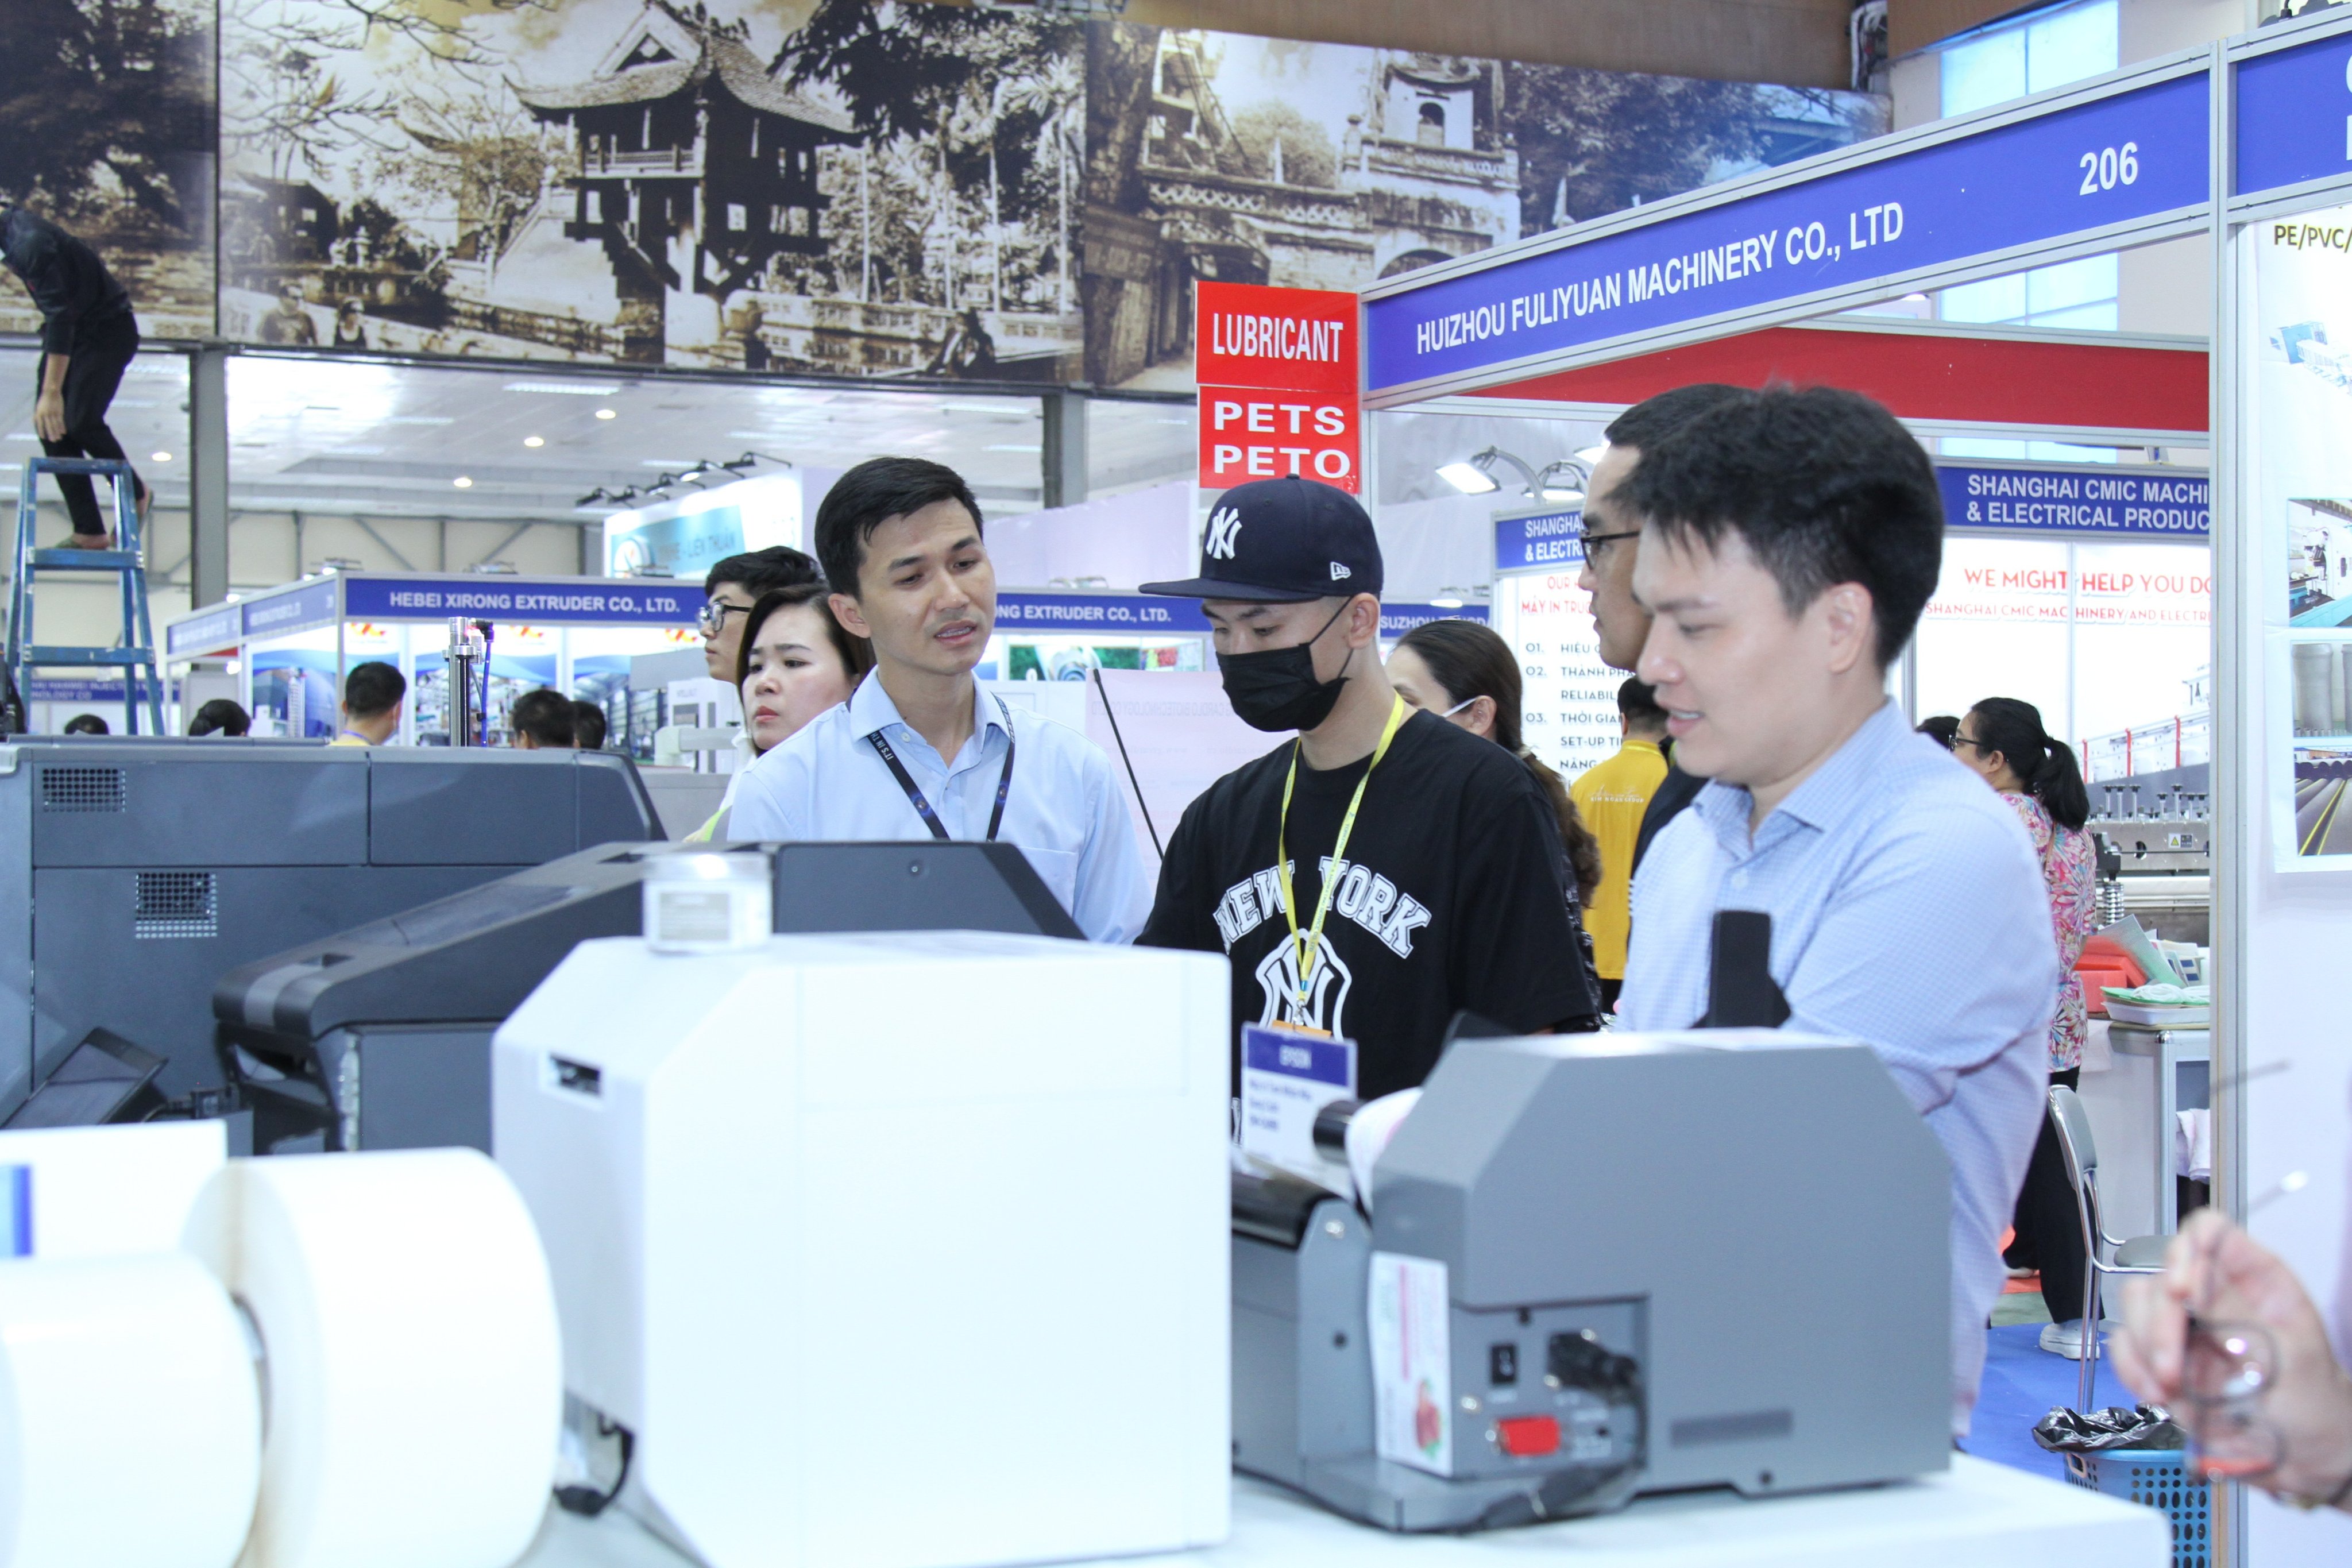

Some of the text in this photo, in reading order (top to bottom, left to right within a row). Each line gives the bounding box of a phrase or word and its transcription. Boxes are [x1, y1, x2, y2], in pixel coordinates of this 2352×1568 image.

[2079, 141, 2138, 196] 206
[1417, 202, 1904, 356] HUIZHOU FULIYUAN MACHINERY CO., LTD
[1213, 313, 1344, 363] LUBRICANT
[1215, 401, 1345, 436] PETS
[1214, 445, 1350, 479] PETO
[1968, 474, 2079, 500] SHANGHAI
[2085, 479, 2137, 501] CMIC
[1967, 501, 1982, 523] &
[1988, 502, 2119, 527] ELECTRICAL
[1525, 543, 1534, 562] &
[1964, 569, 1996, 587] WE
[2002, 570, 2067, 590] MIGHT
[2081, 573, 2134, 592] HELP
[2140, 574, 2184, 593] YOU
[389, 592, 681, 614] HEBEI XIRONG EXTRUDER CO., LTD.
[1024, 605, 1104, 620] EXTRUDER
[1107, 607, 1137, 623] CO.,
[1140, 608, 1171, 622] LTD.
[1926, 603, 1997, 615] SHANGHAI
[2001, 605, 2035, 616] CMIC
[2129, 609, 2156, 620] AND
[1561, 737, 1605, 747] SET-UP
[1213, 856, 1432, 959] NEW YORK
